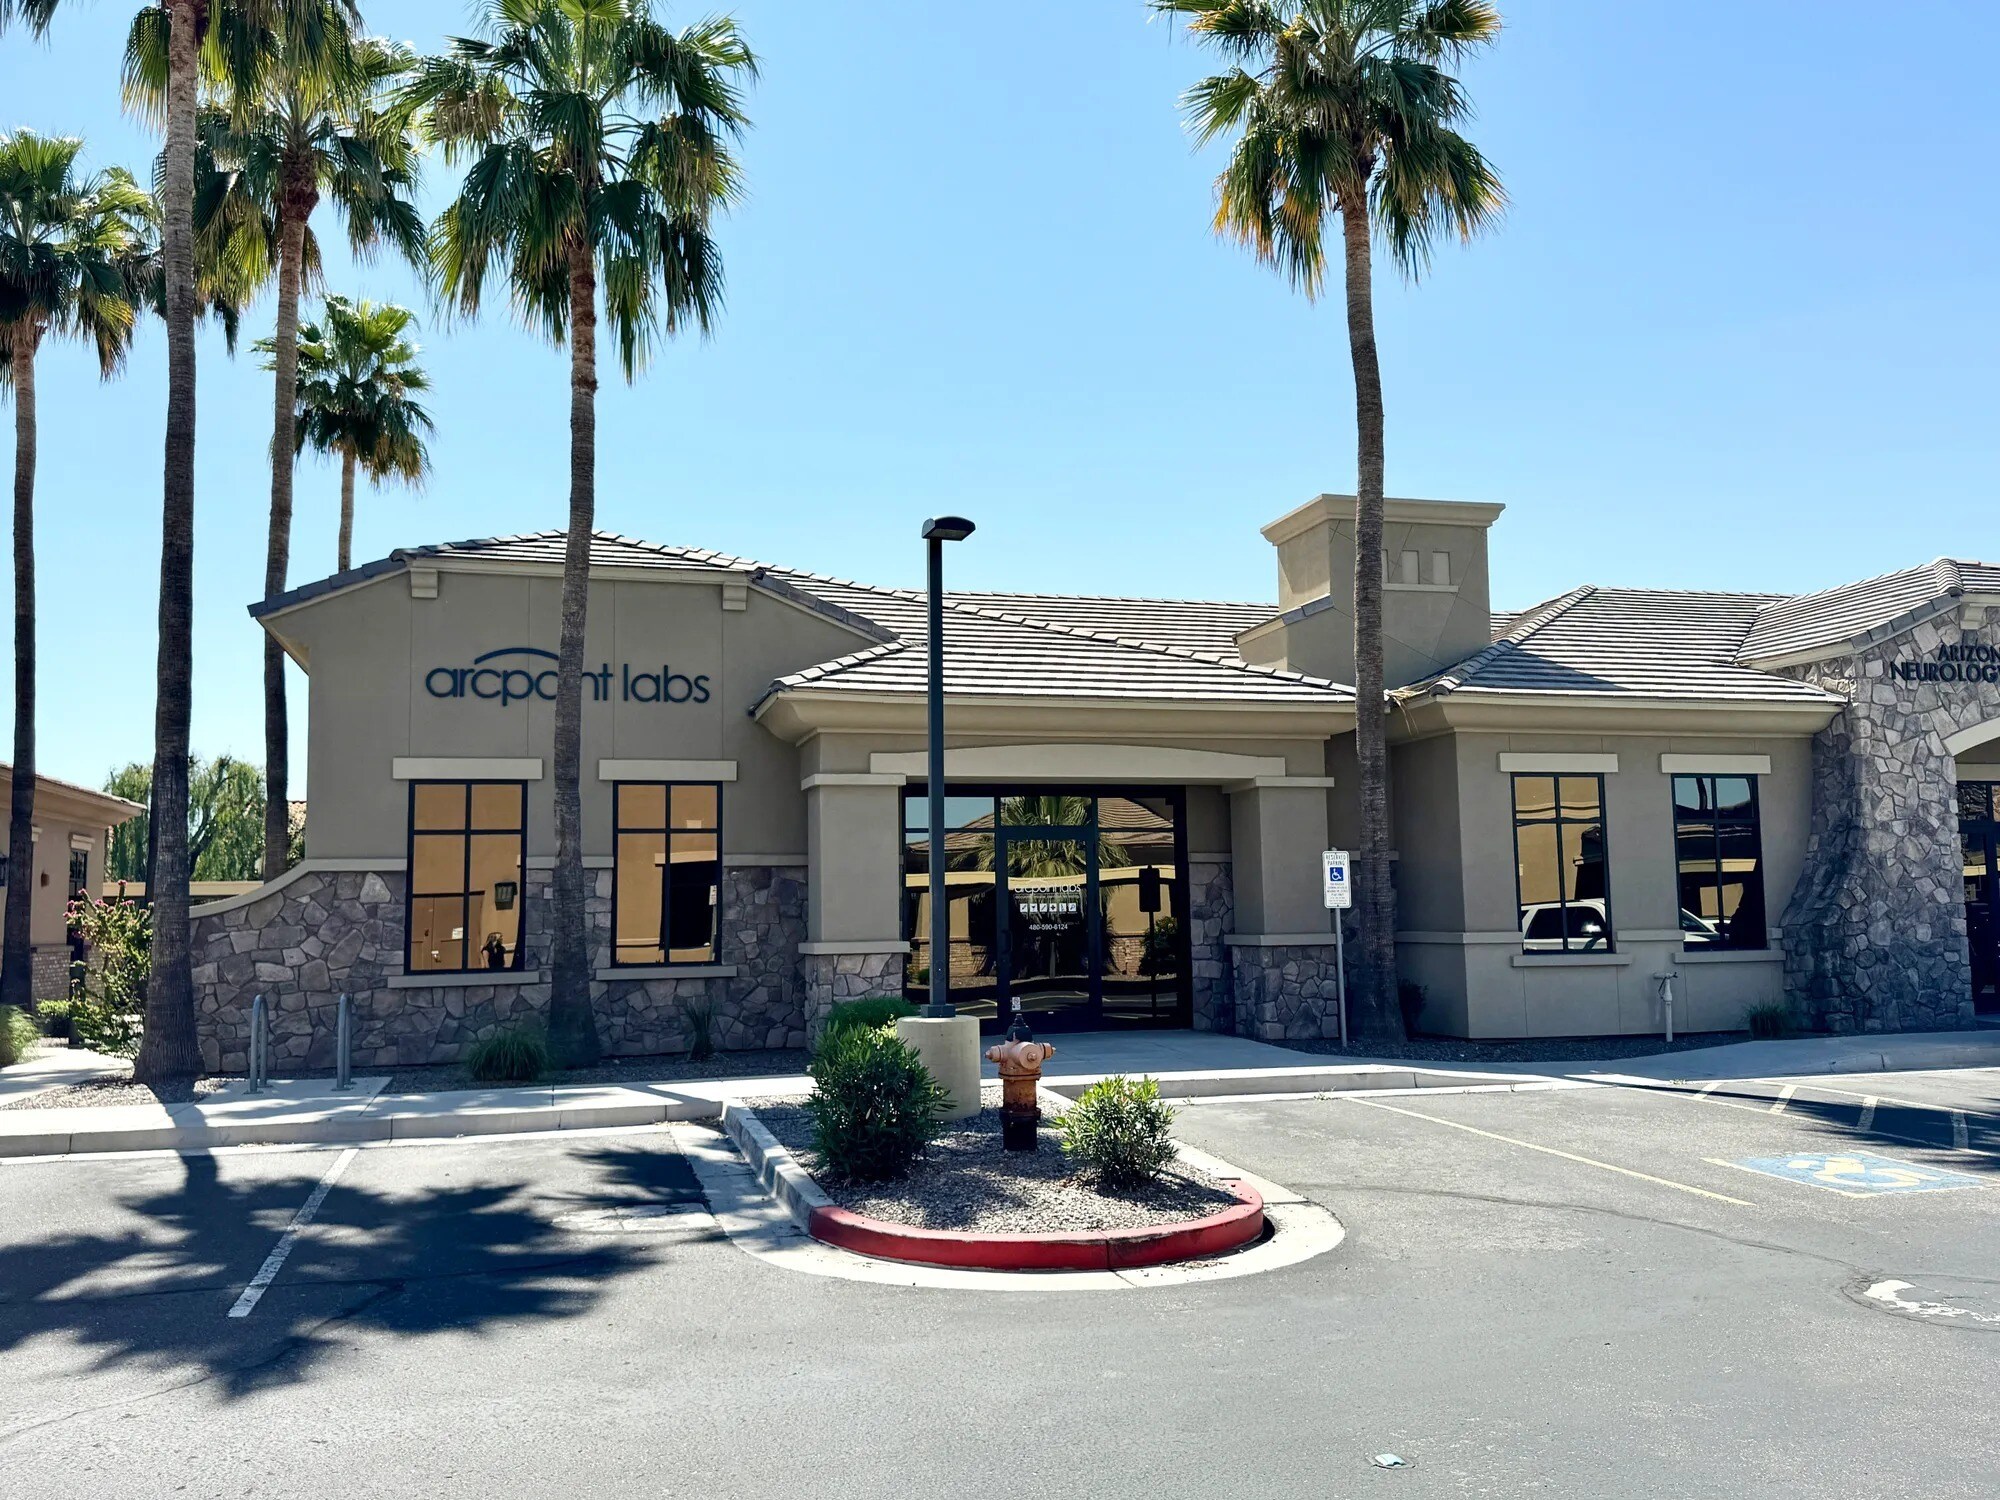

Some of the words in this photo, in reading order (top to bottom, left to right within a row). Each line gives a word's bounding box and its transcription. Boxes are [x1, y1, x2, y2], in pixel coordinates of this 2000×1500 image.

[425, 663, 613, 706] arcpont
[623, 663, 711, 704] labs
[1890, 661, 2000, 683] NEUROLOG
